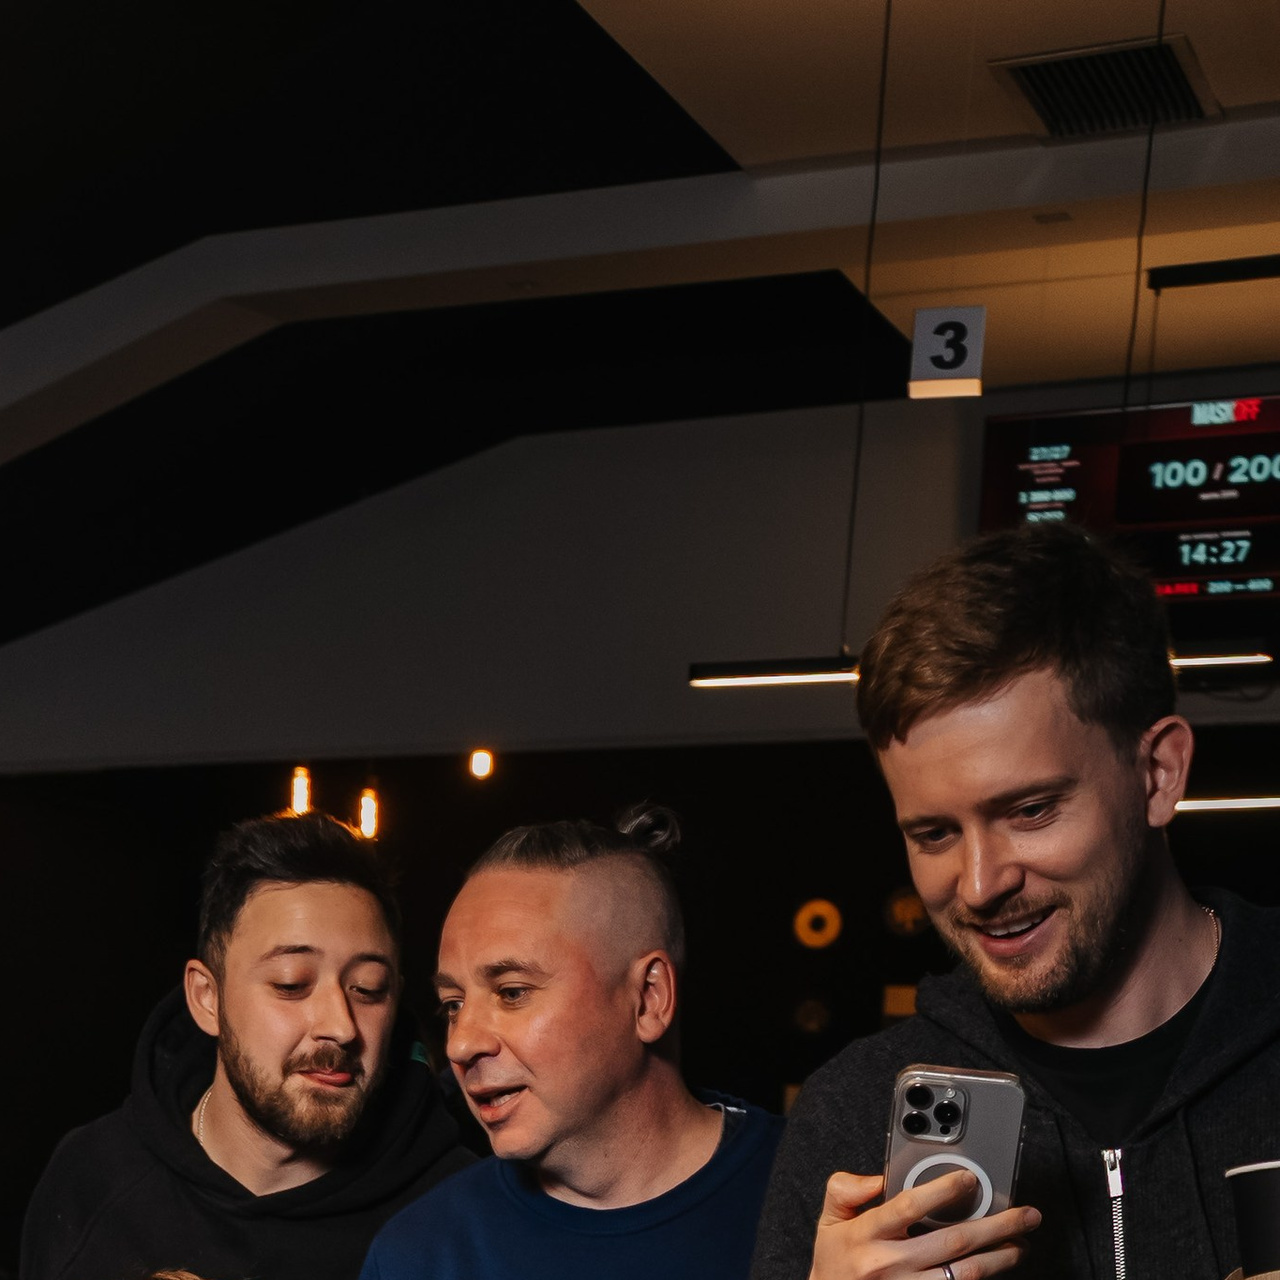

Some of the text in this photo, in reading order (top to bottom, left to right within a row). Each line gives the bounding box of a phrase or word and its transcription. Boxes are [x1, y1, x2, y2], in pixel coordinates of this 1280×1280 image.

[930, 321, 968, 370] 3
[1149, 459, 1208, 489] 100
[1179, 540, 1251, 566] 14:27
